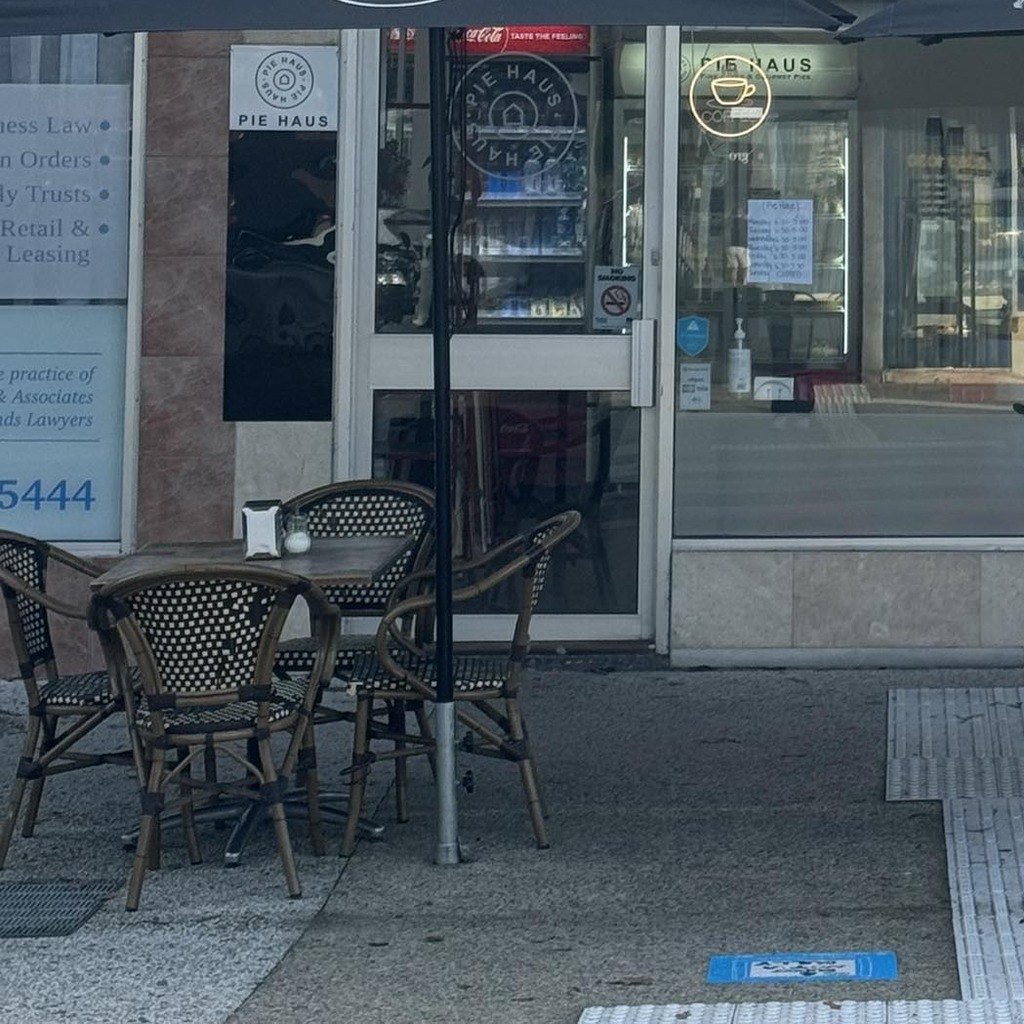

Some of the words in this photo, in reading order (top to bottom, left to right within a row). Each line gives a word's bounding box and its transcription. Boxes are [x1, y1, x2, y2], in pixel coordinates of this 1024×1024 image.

[47, 116, 92, 134] Law
[239, 115, 268, 127] PIE
[278, 115, 329, 128] HAUS
[20, 150, 92, 168] Orders
[25, 185, 92, 203] Trusts
[0, 219, 63, 237] Retail
[71, 219, 90, 238] &
[8, 242, 90, 267] Leasing
[9, 367, 76, 385] practice
[79, 366, 98, 385] of
[12, 389, 94, 405] Associates
[28, 413, 93, 430] Lawyers
